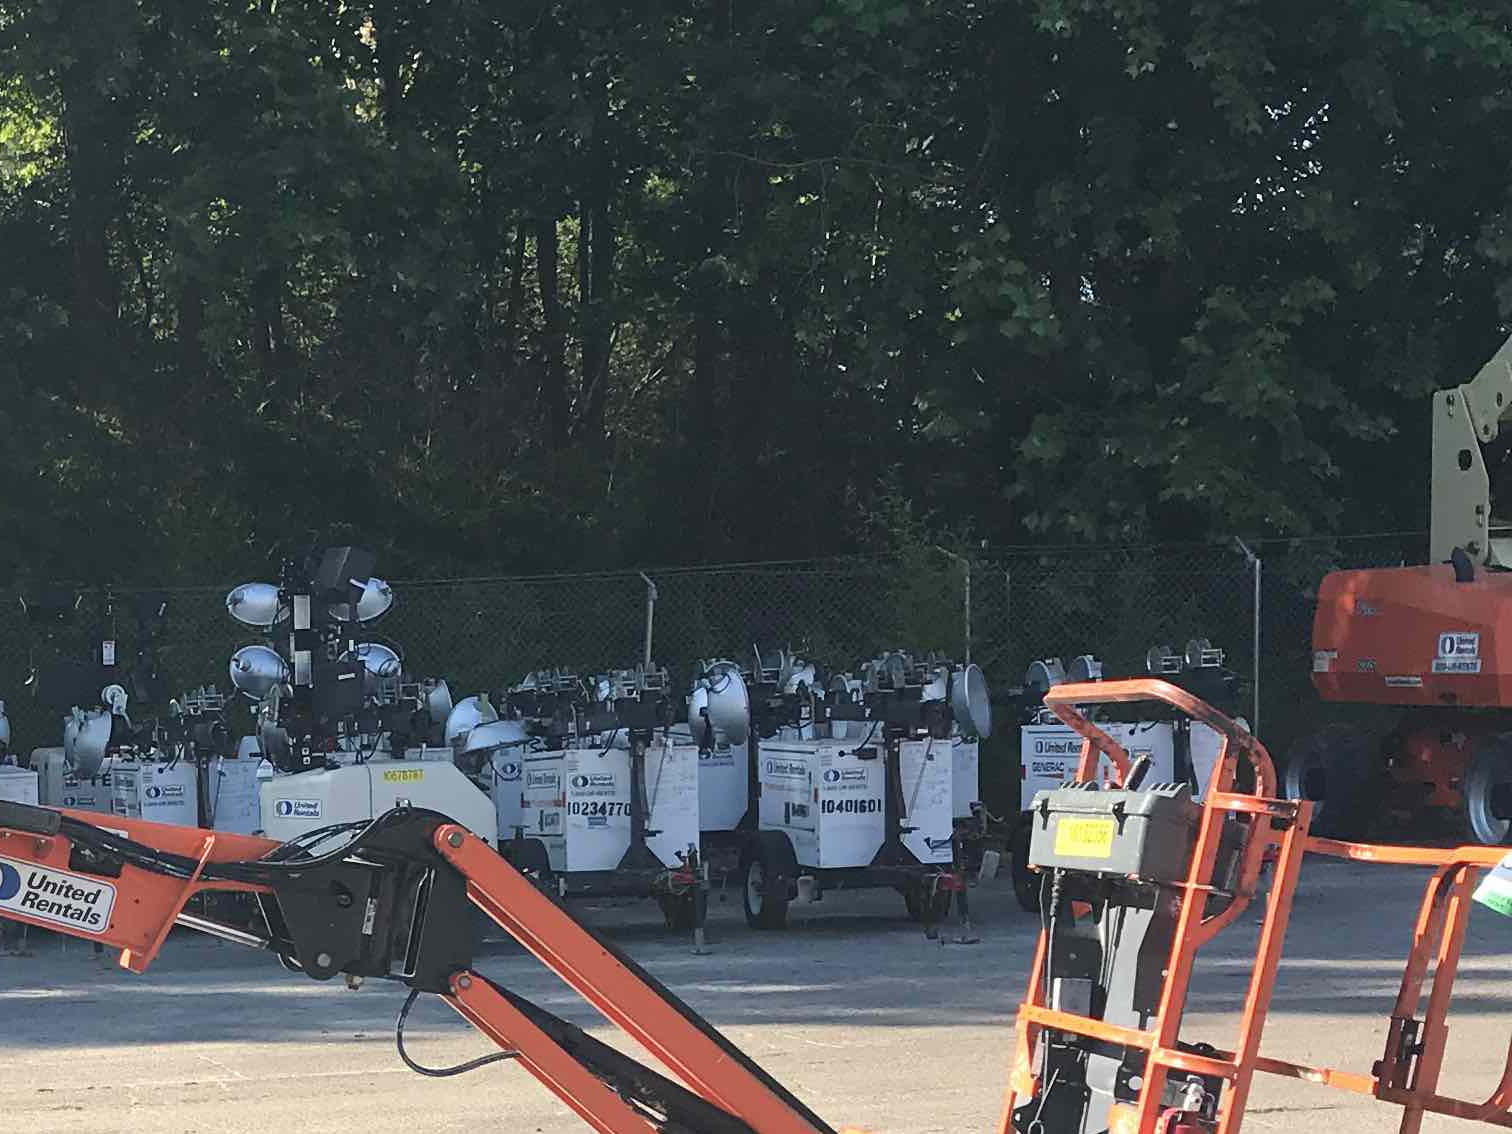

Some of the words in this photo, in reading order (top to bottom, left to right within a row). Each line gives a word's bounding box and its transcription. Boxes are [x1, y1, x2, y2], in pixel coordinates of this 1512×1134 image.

[568, 801, 632, 817] 10234770
[821, 799, 882, 814] 10401601
[26, 871, 102, 906] United
[20, 890, 102, 927] Rentals
